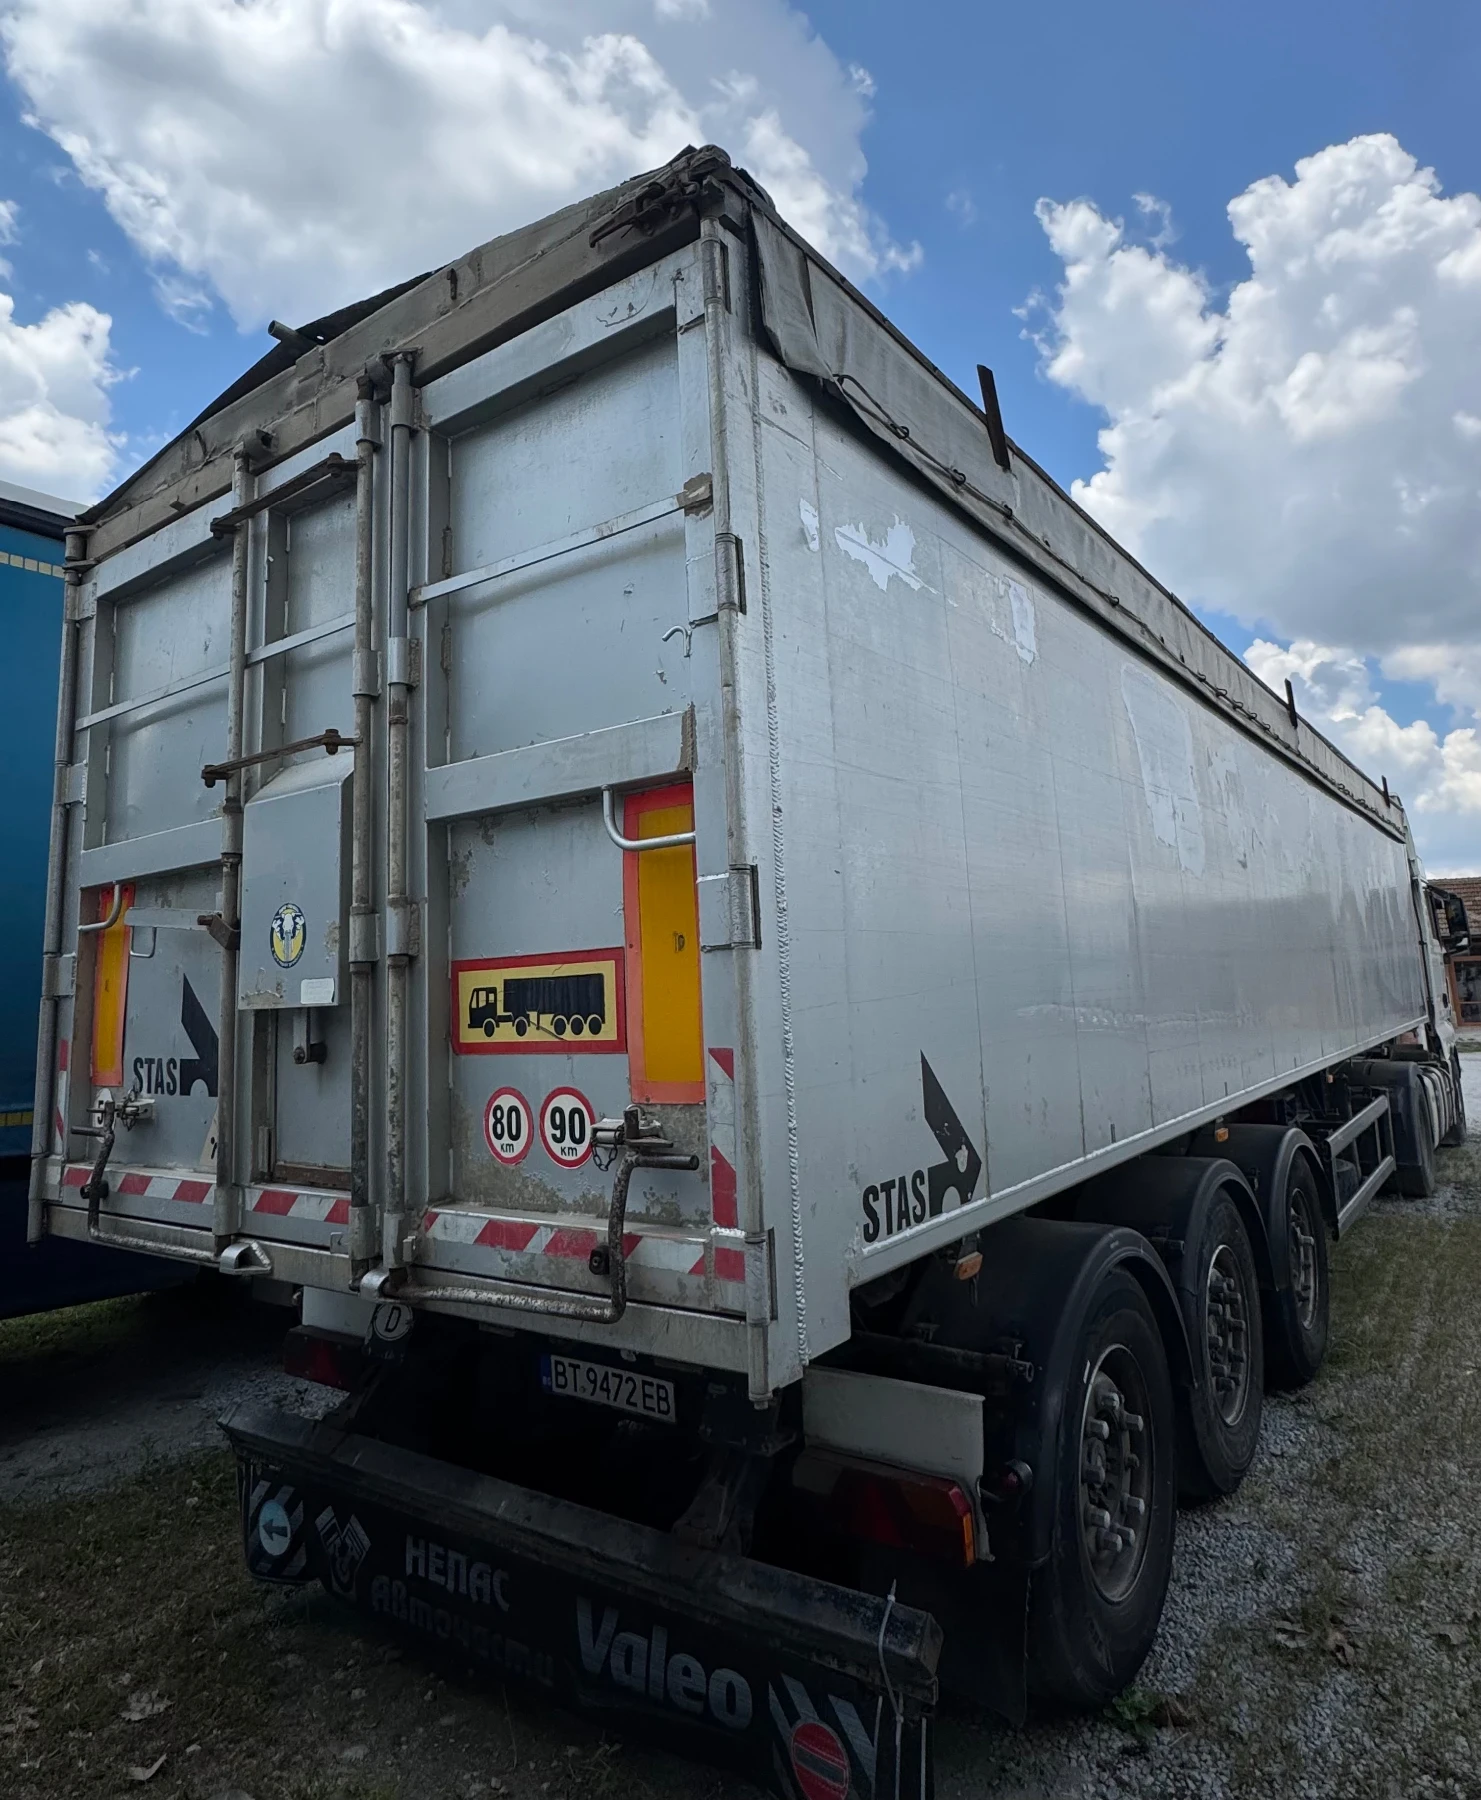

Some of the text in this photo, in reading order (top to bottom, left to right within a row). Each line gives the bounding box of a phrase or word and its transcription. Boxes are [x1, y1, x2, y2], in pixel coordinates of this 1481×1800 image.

[133, 1057, 178, 1096] STAS
[492, 1105, 521, 1141] 80
[550, 1106, 586, 1145] 90
[862, 1169, 926, 1243] STAS
[576, 1594, 753, 1731] Valeo
